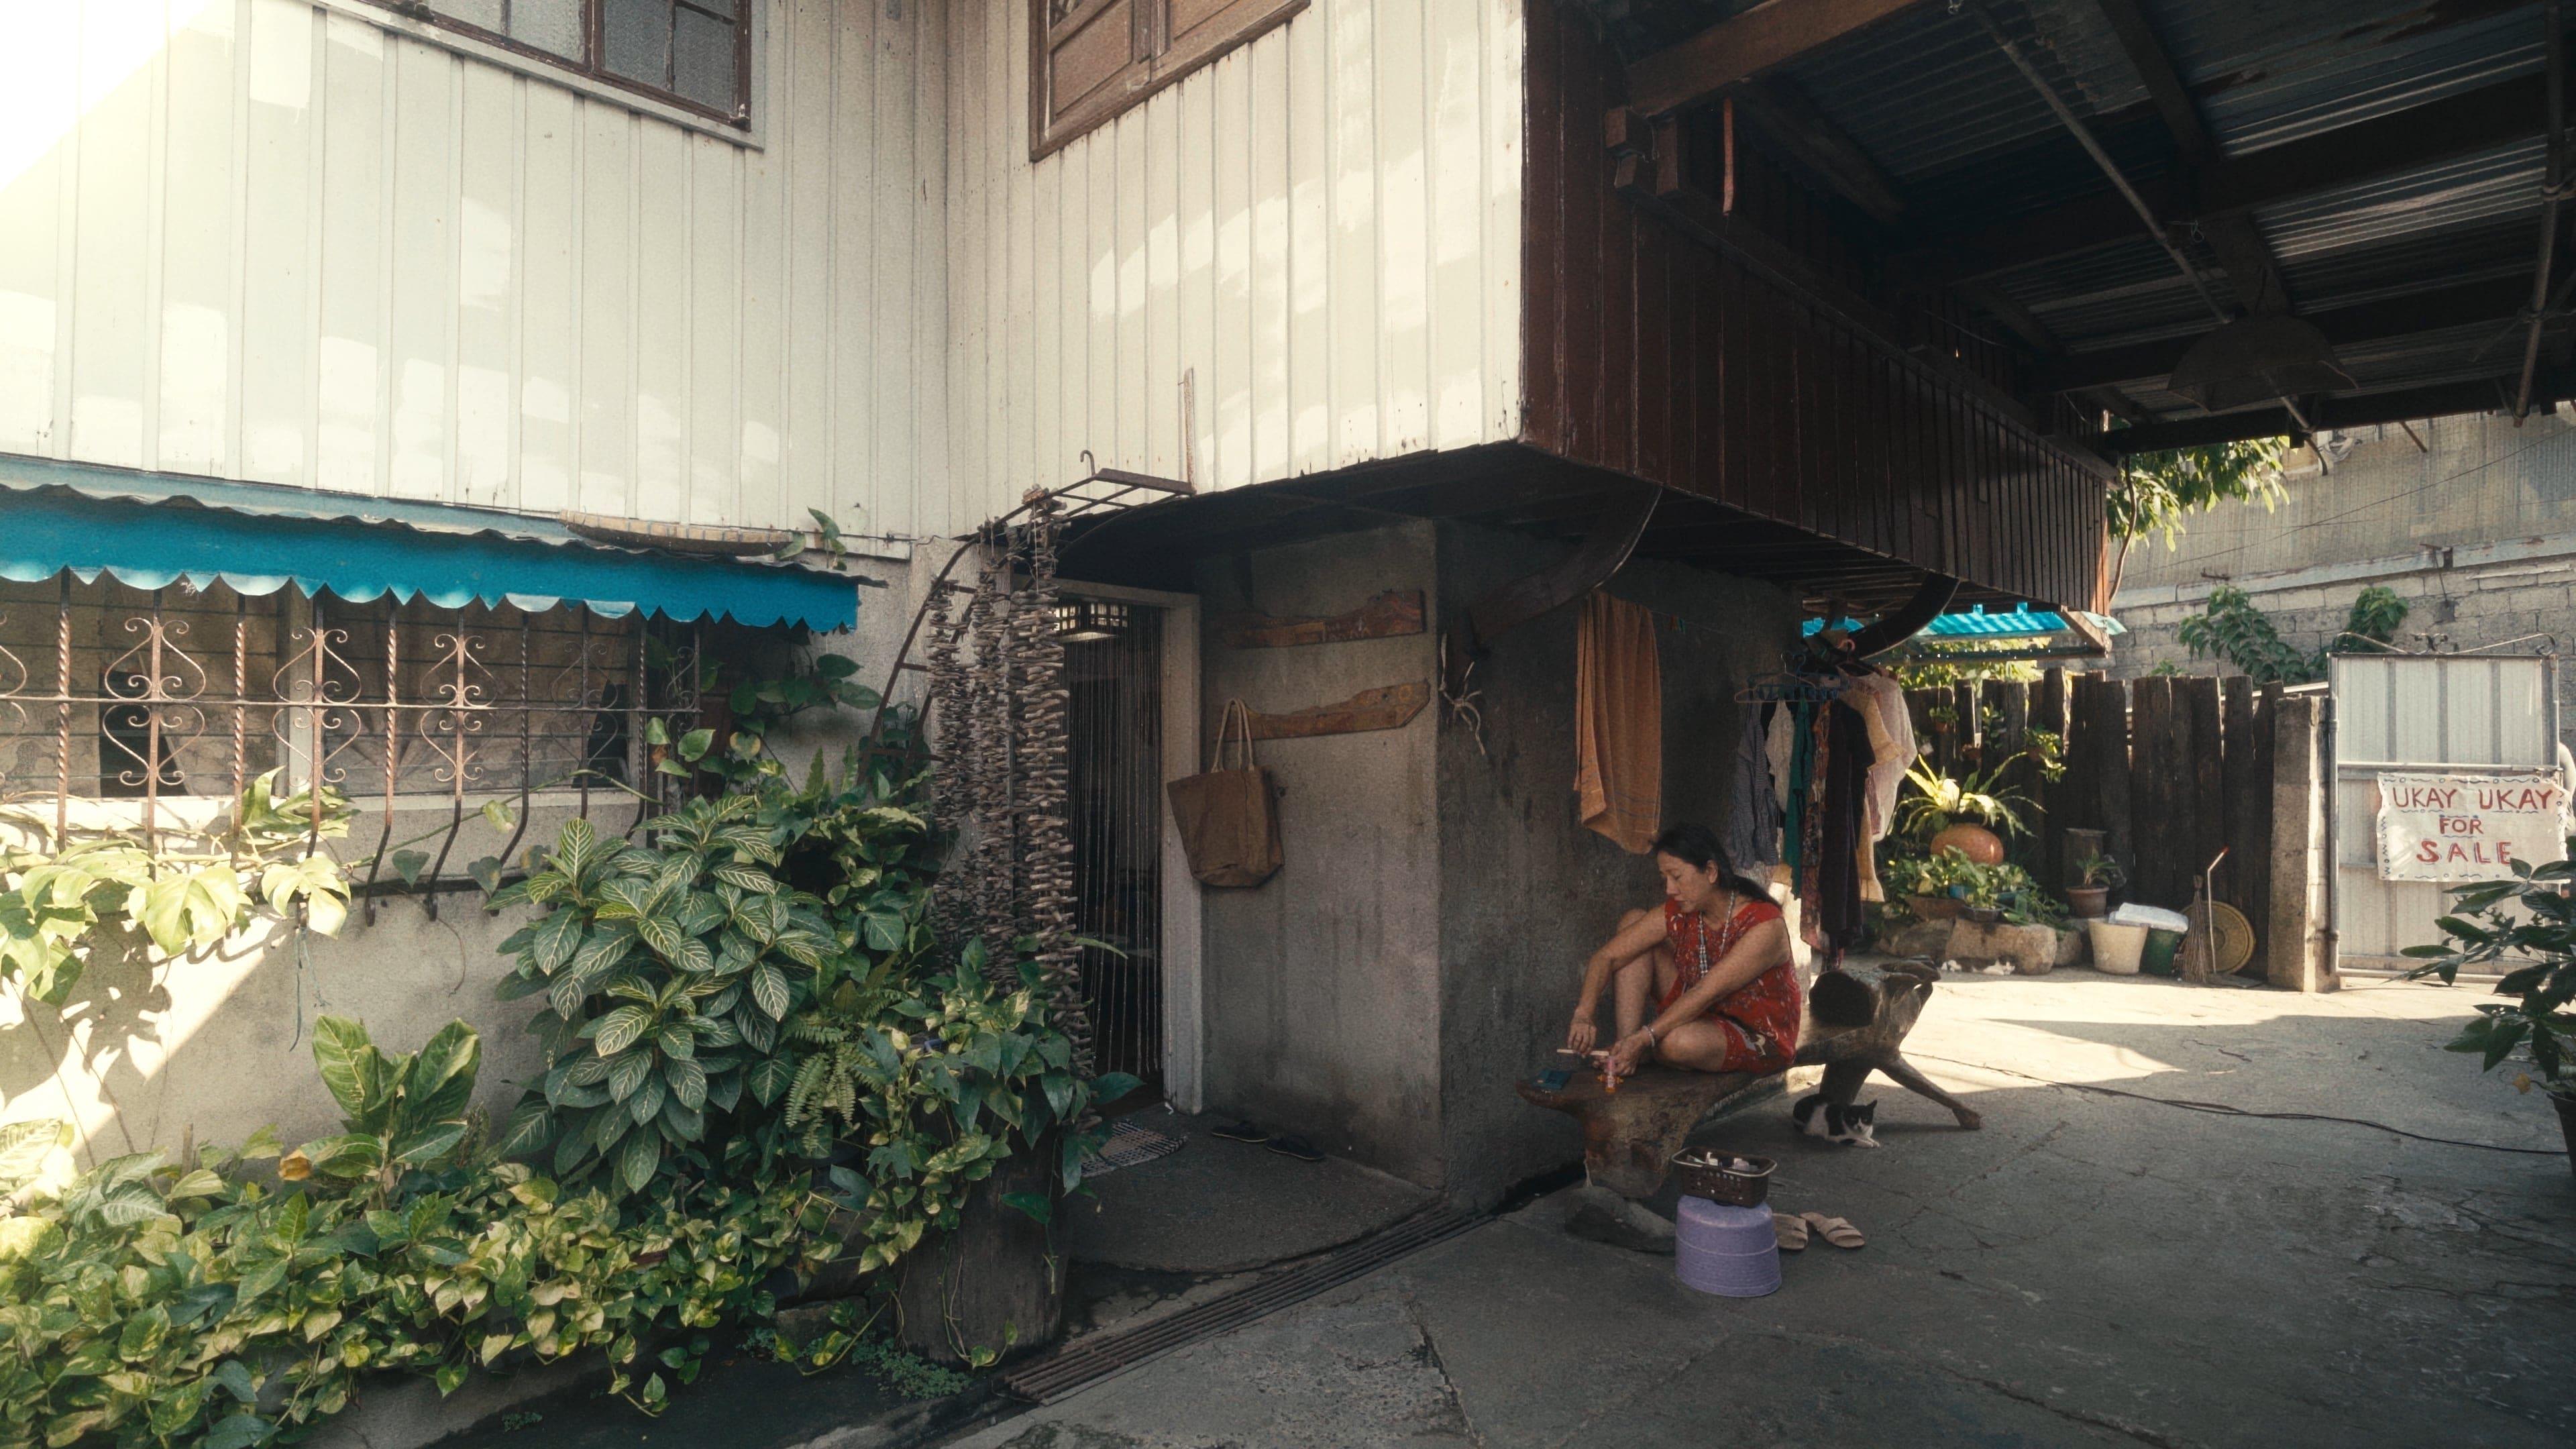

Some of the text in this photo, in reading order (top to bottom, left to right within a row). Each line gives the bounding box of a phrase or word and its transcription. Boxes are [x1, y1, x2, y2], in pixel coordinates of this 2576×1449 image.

[2393, 787, 2553, 810] UKAY UKAY
[2439, 818, 2484, 835] FOR
[2416, 841, 2512, 865] SALE
